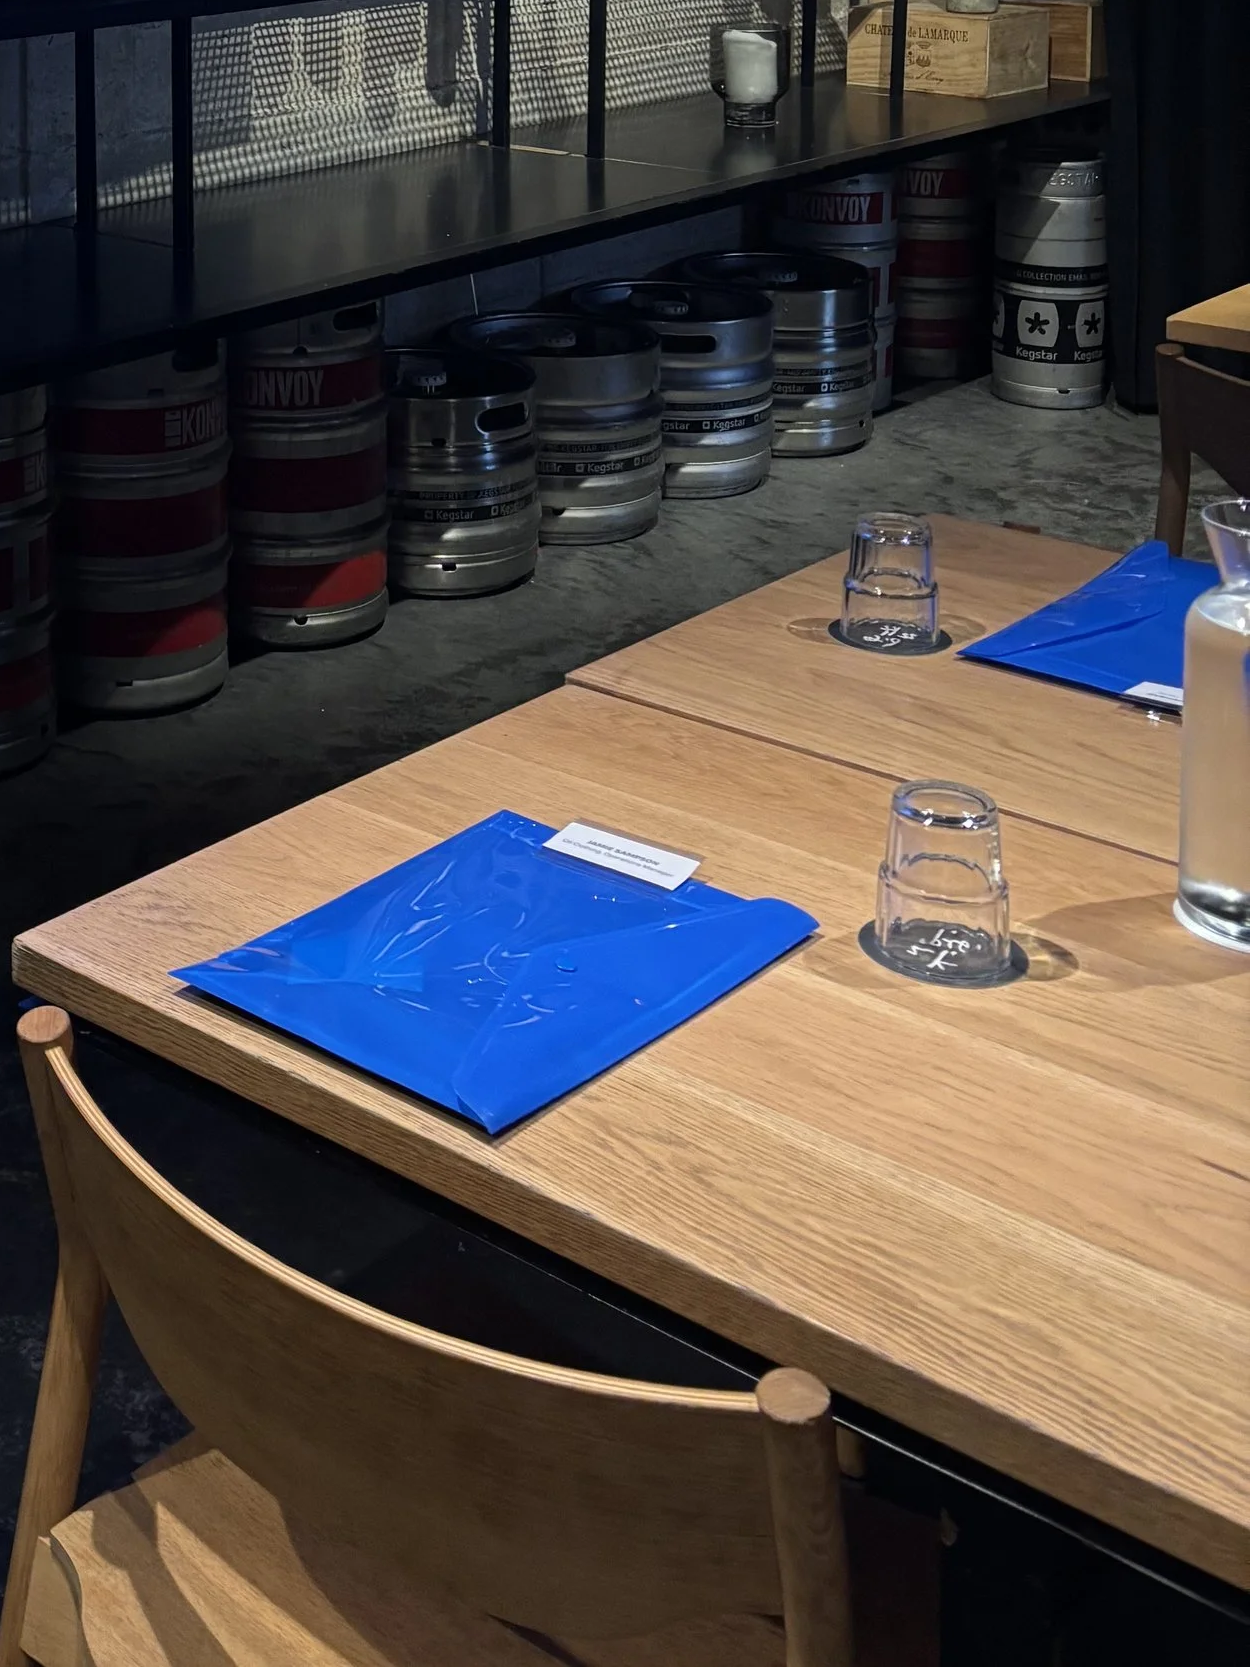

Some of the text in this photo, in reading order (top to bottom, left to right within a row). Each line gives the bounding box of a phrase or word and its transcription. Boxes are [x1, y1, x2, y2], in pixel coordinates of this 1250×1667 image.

[864, 23, 969, 43] CHATE de LAMARQUE
[1015, 346, 1059, 361] Kegstar
[1074, 350, 1104, 362] Kegs
[244, 369, 325, 407] ONVOY
[713, 418, 746, 432] Kegstar
[587, 461, 625, 474] Kegstar
[436, 510, 475, 522] Kegstar
